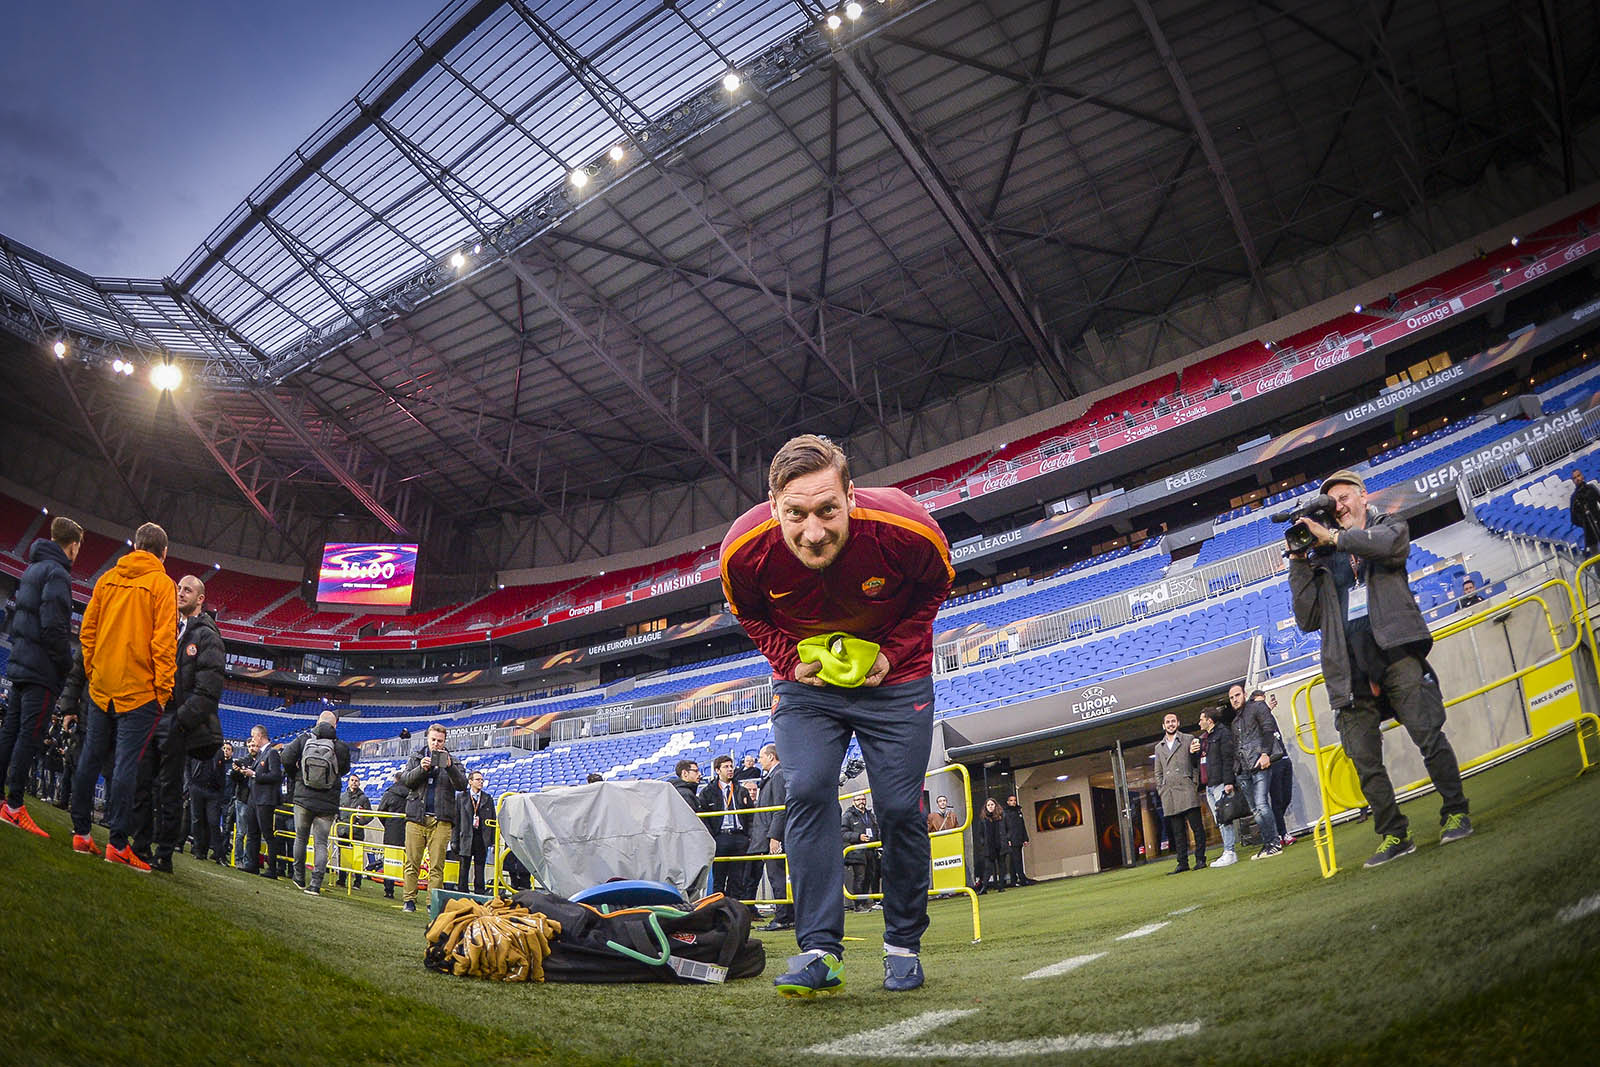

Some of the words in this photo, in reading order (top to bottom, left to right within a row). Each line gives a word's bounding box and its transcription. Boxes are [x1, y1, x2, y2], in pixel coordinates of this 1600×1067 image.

[1407, 305, 1450, 329] Orange
[1344, 403, 1376, 421] UEFA
[1376, 385, 1421, 409] EUROPA
[1422, 365, 1464, 390] LEAGUE
[1414, 466, 1459, 493] UEFA
[1461, 437, 1521, 474] EUROPA
[1524, 408, 1583, 445] LEAGUE
[1165, 469, 1207, 490] FedEx
[950, 544, 976, 560] ROPA
[978, 530, 1022, 551] LEAGUE
[651, 572, 701, 596] SAMSUNG
[1128, 576, 1197, 607] FedEx
[569, 604, 594, 617] Orange
[588, 645, 606, 655] UEFA
[607, 639, 633, 652] EUROPA
[634, 631, 662, 645] LEAGUE
[396, 677, 417, 685] EUROPA
[418, 676, 439, 684] LEAGUE
[1072, 695, 1118, 714] EUROPA
[1081, 707, 1112, 719] LEAGUE
